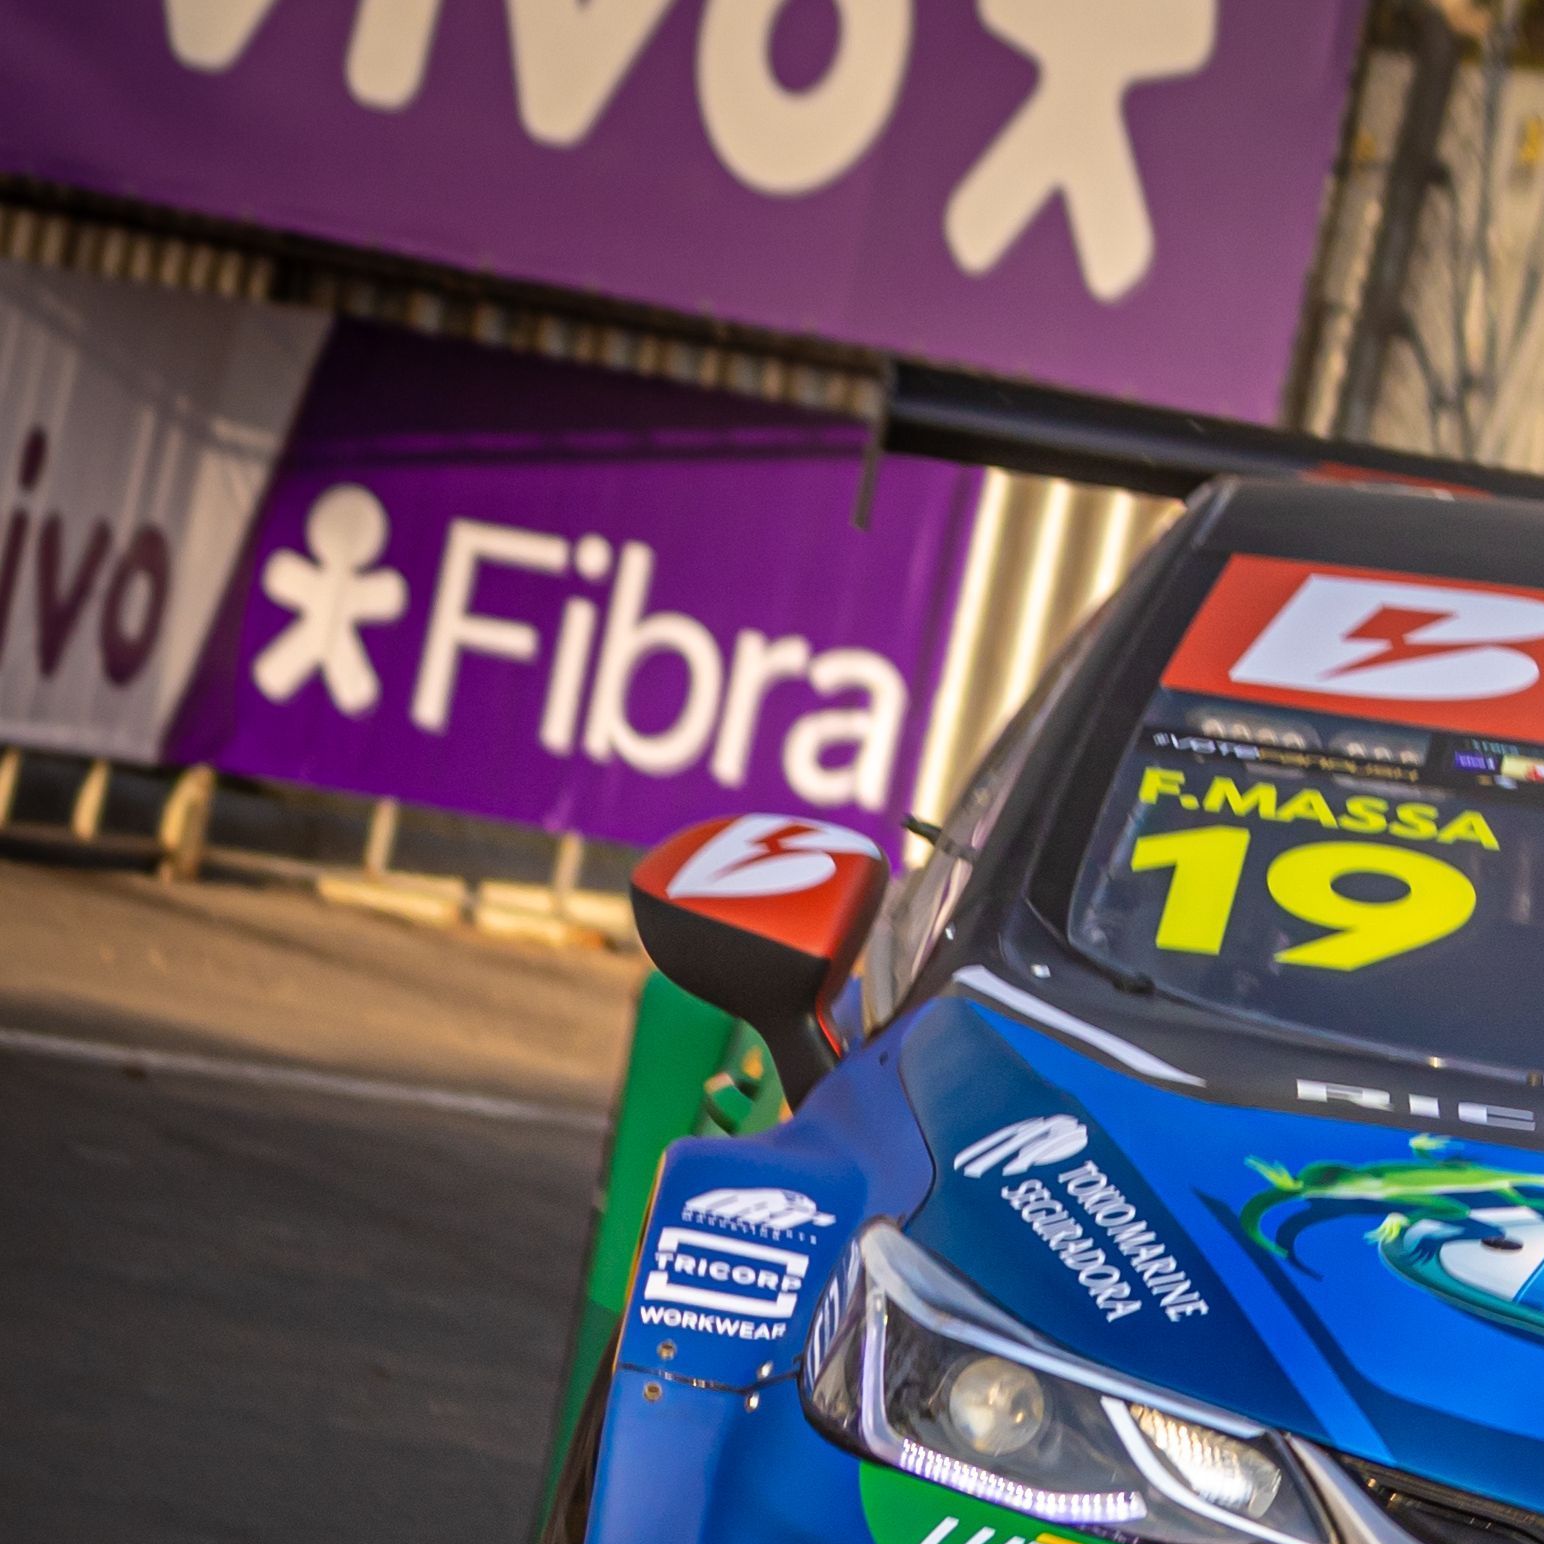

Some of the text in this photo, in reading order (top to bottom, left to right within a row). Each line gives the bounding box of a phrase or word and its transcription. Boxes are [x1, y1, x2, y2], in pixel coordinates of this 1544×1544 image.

[0, 420, 171, 690] ivo
[410, 515, 908, 812] Fibra
[1139, 766, 1501, 852] F.MASSA
[1131, 824, 1477, 972] 19
[640, 1305, 787, 1341] WORKWEAR
[655, 1251, 803, 1292] TRICORP
